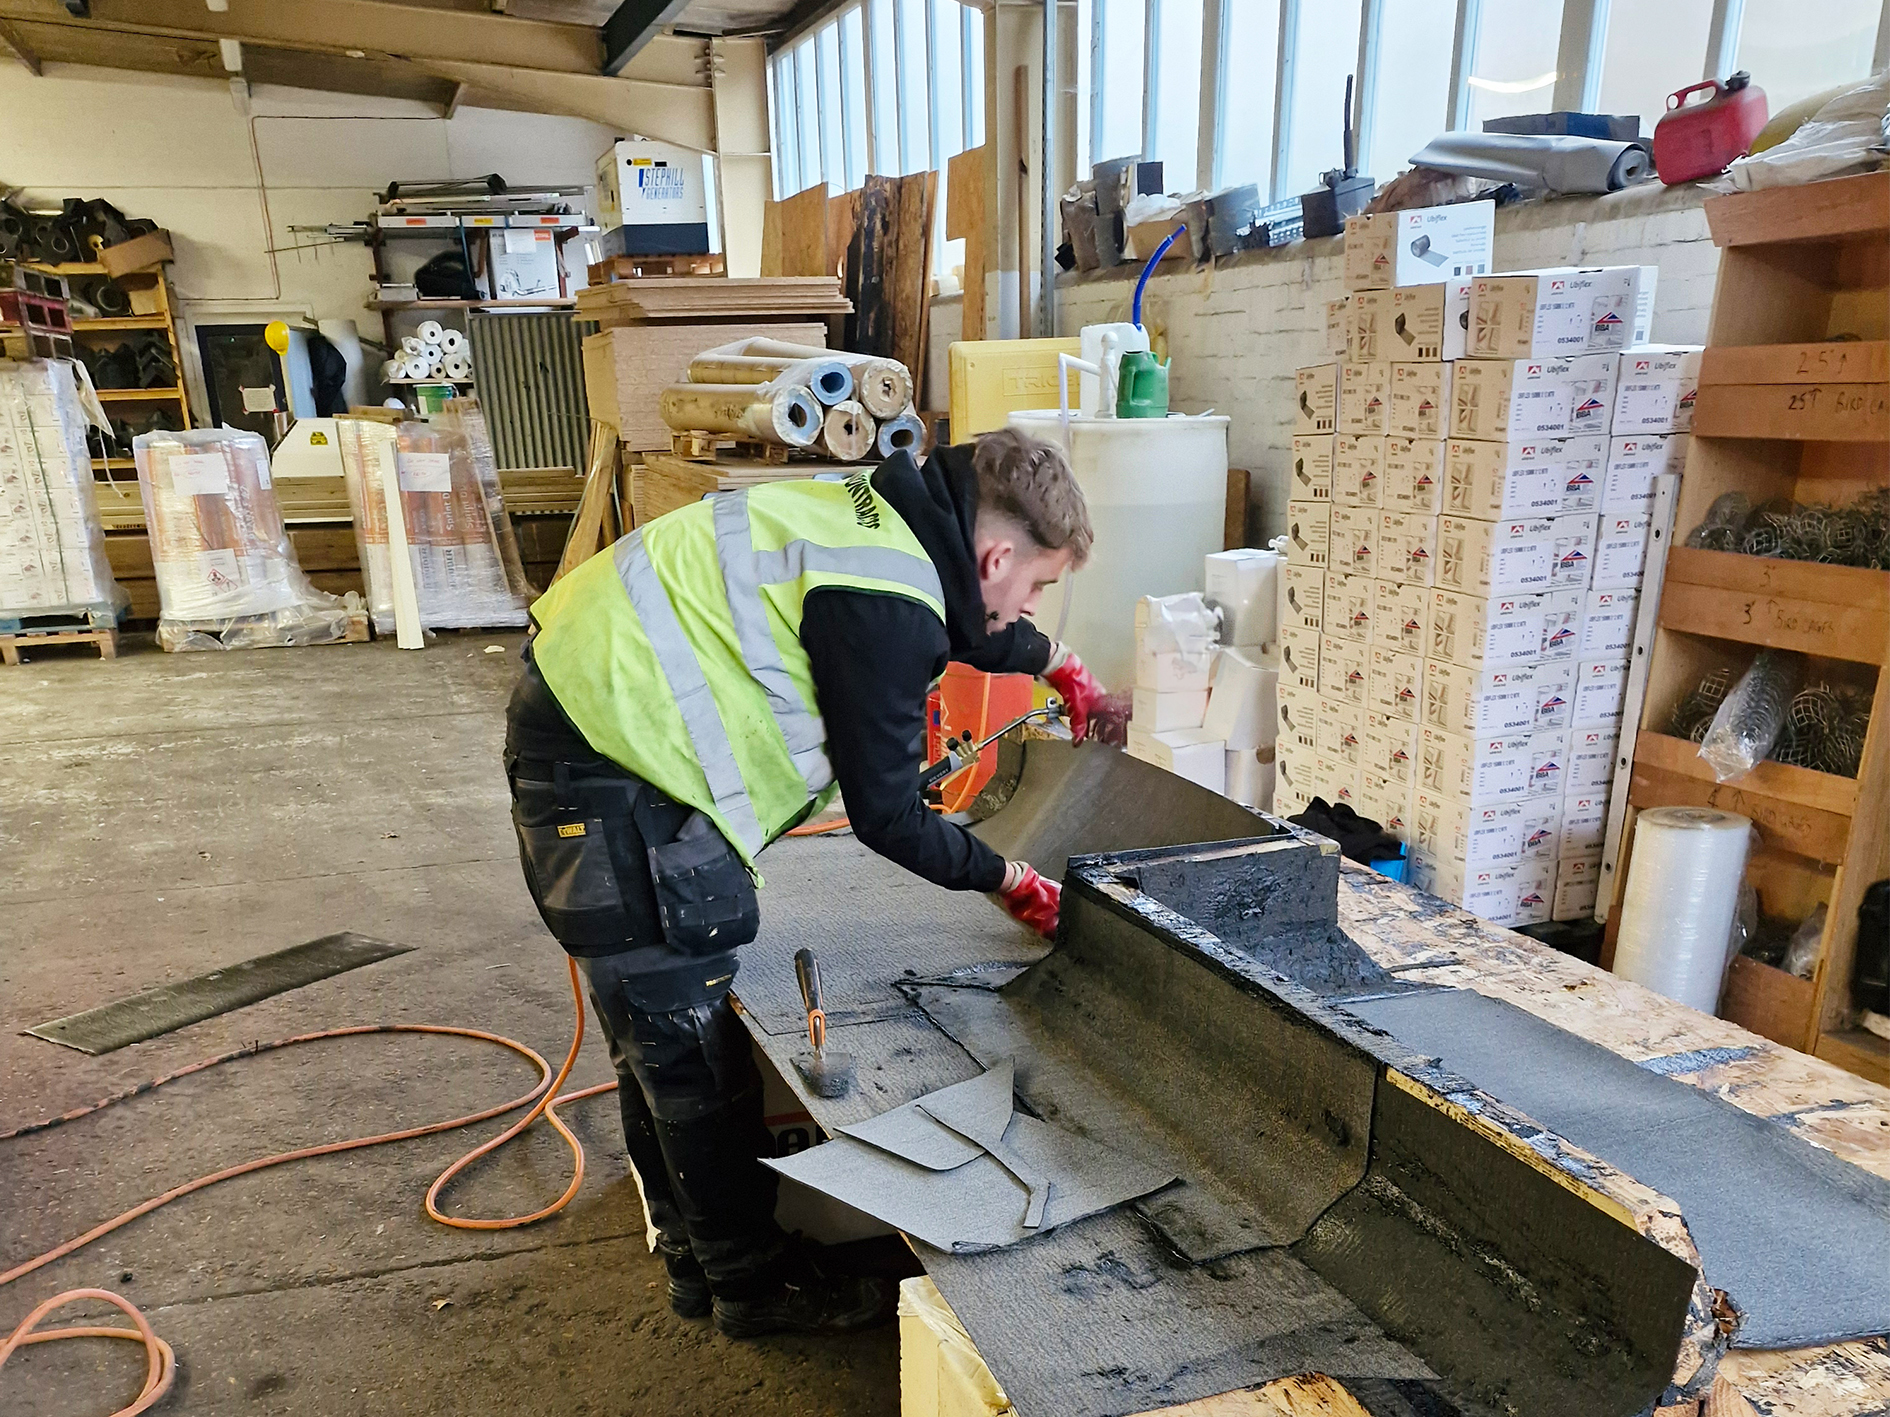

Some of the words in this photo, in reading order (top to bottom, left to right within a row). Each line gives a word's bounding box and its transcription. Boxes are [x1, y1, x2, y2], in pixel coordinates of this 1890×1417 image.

[644, 168, 684, 186] STEPHILL
[1569, 280, 1593, 291] Ubiflex
[1557, 336, 1584, 344] 0534001
[1546, 364, 1570, 375] Ubiflex
[1536, 424, 1565, 432] 0534001
[1540, 446, 1563, 455] Ubiflex
[1520, 575, 1547, 583] 0534001
